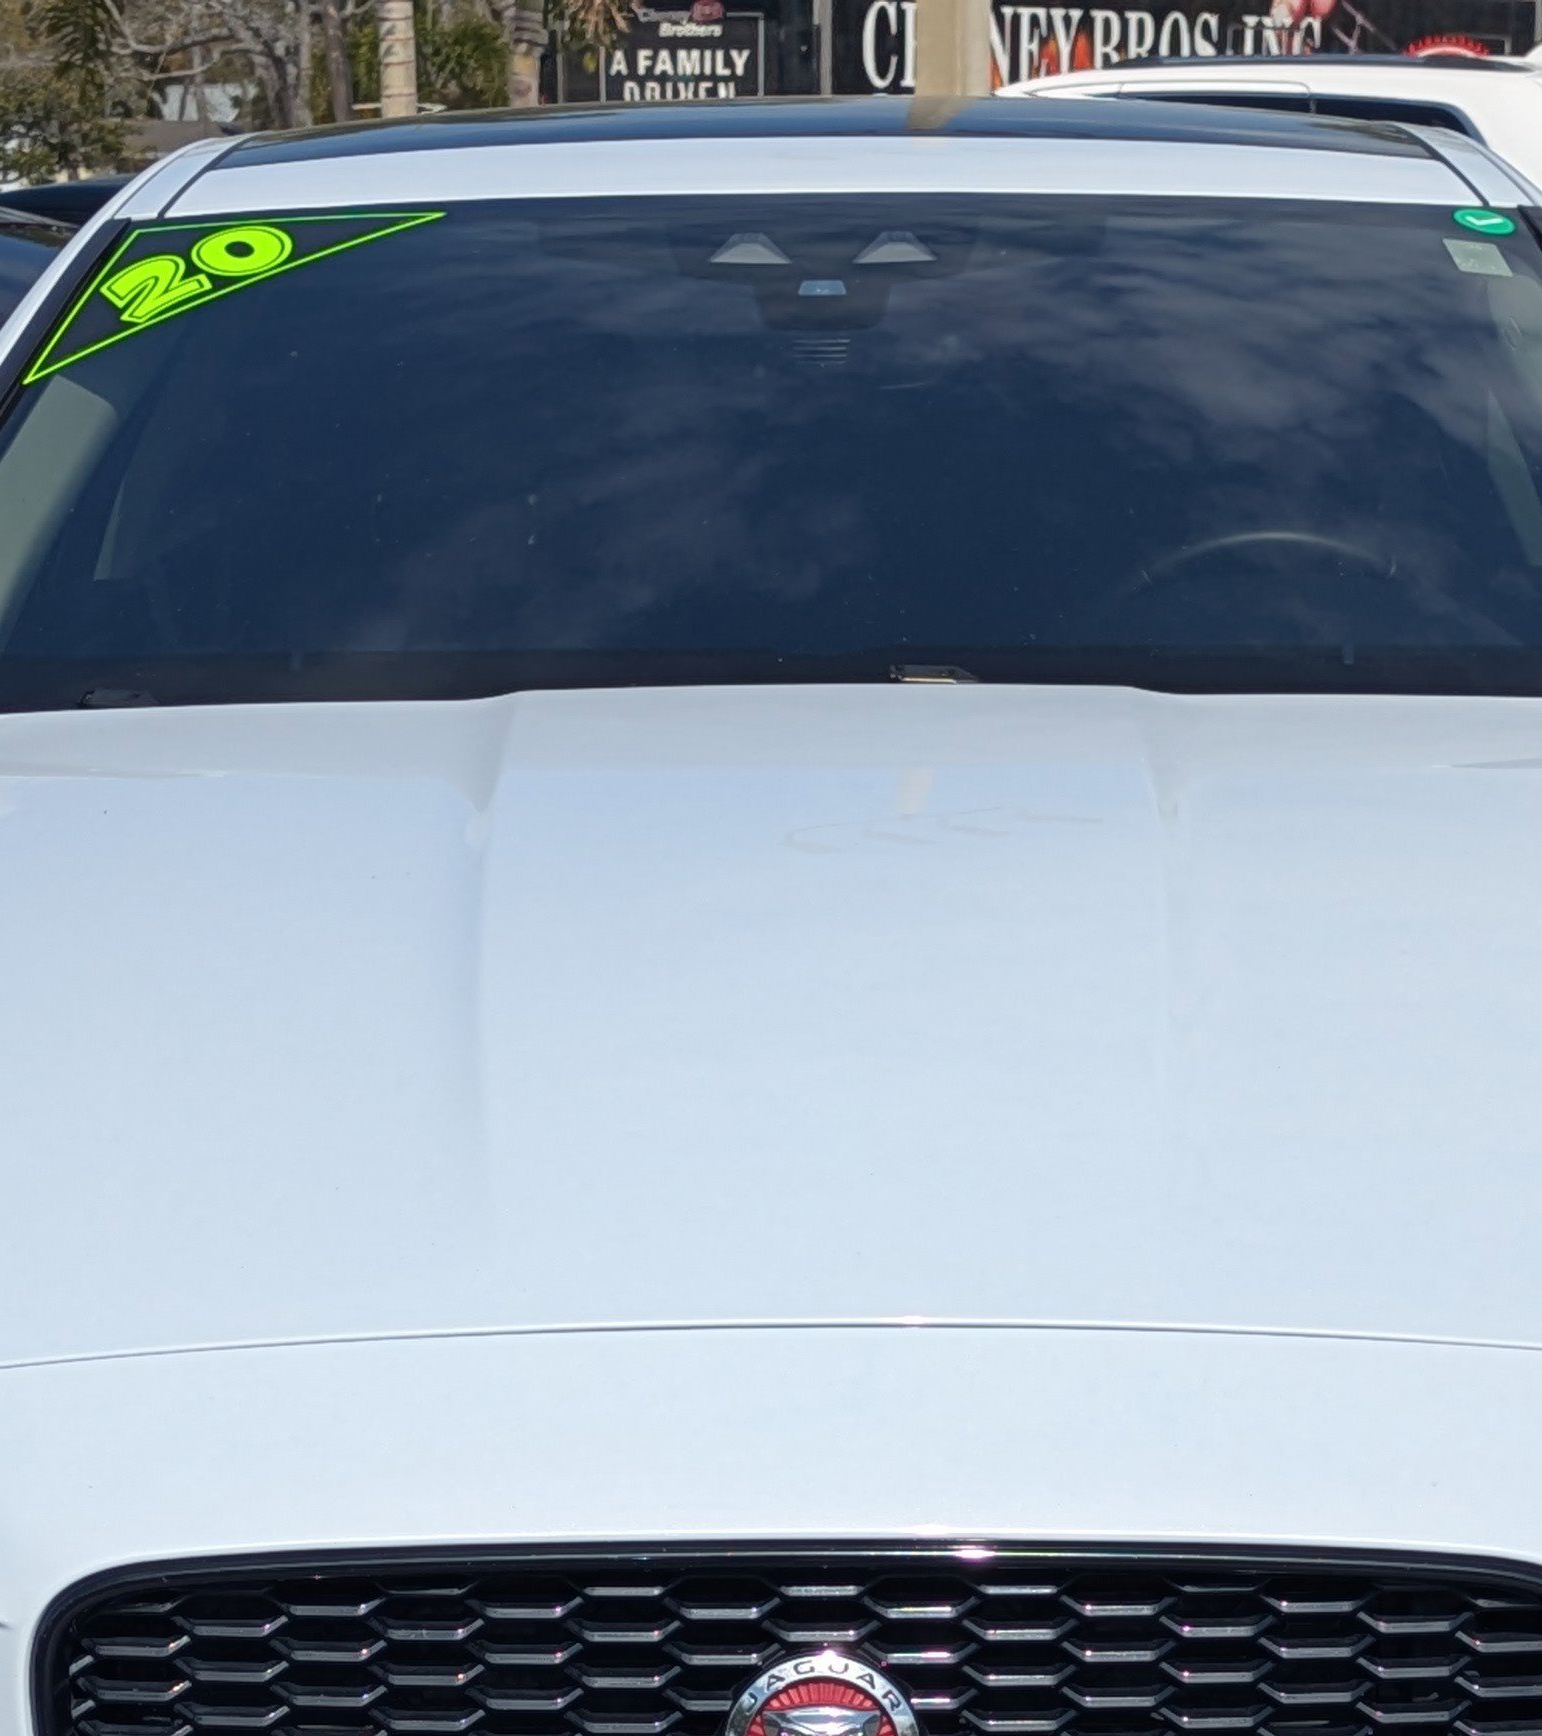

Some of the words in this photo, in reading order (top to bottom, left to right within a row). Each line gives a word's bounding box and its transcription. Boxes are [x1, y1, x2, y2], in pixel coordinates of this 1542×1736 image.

[609, 48, 628, 76] A
[637, 48, 751, 76] FAMILY
[862, 0, 1084, 89] CNEY
[99, 225, 292, 323] 20
[746, 1660, 902, 1716] JAGUAR
